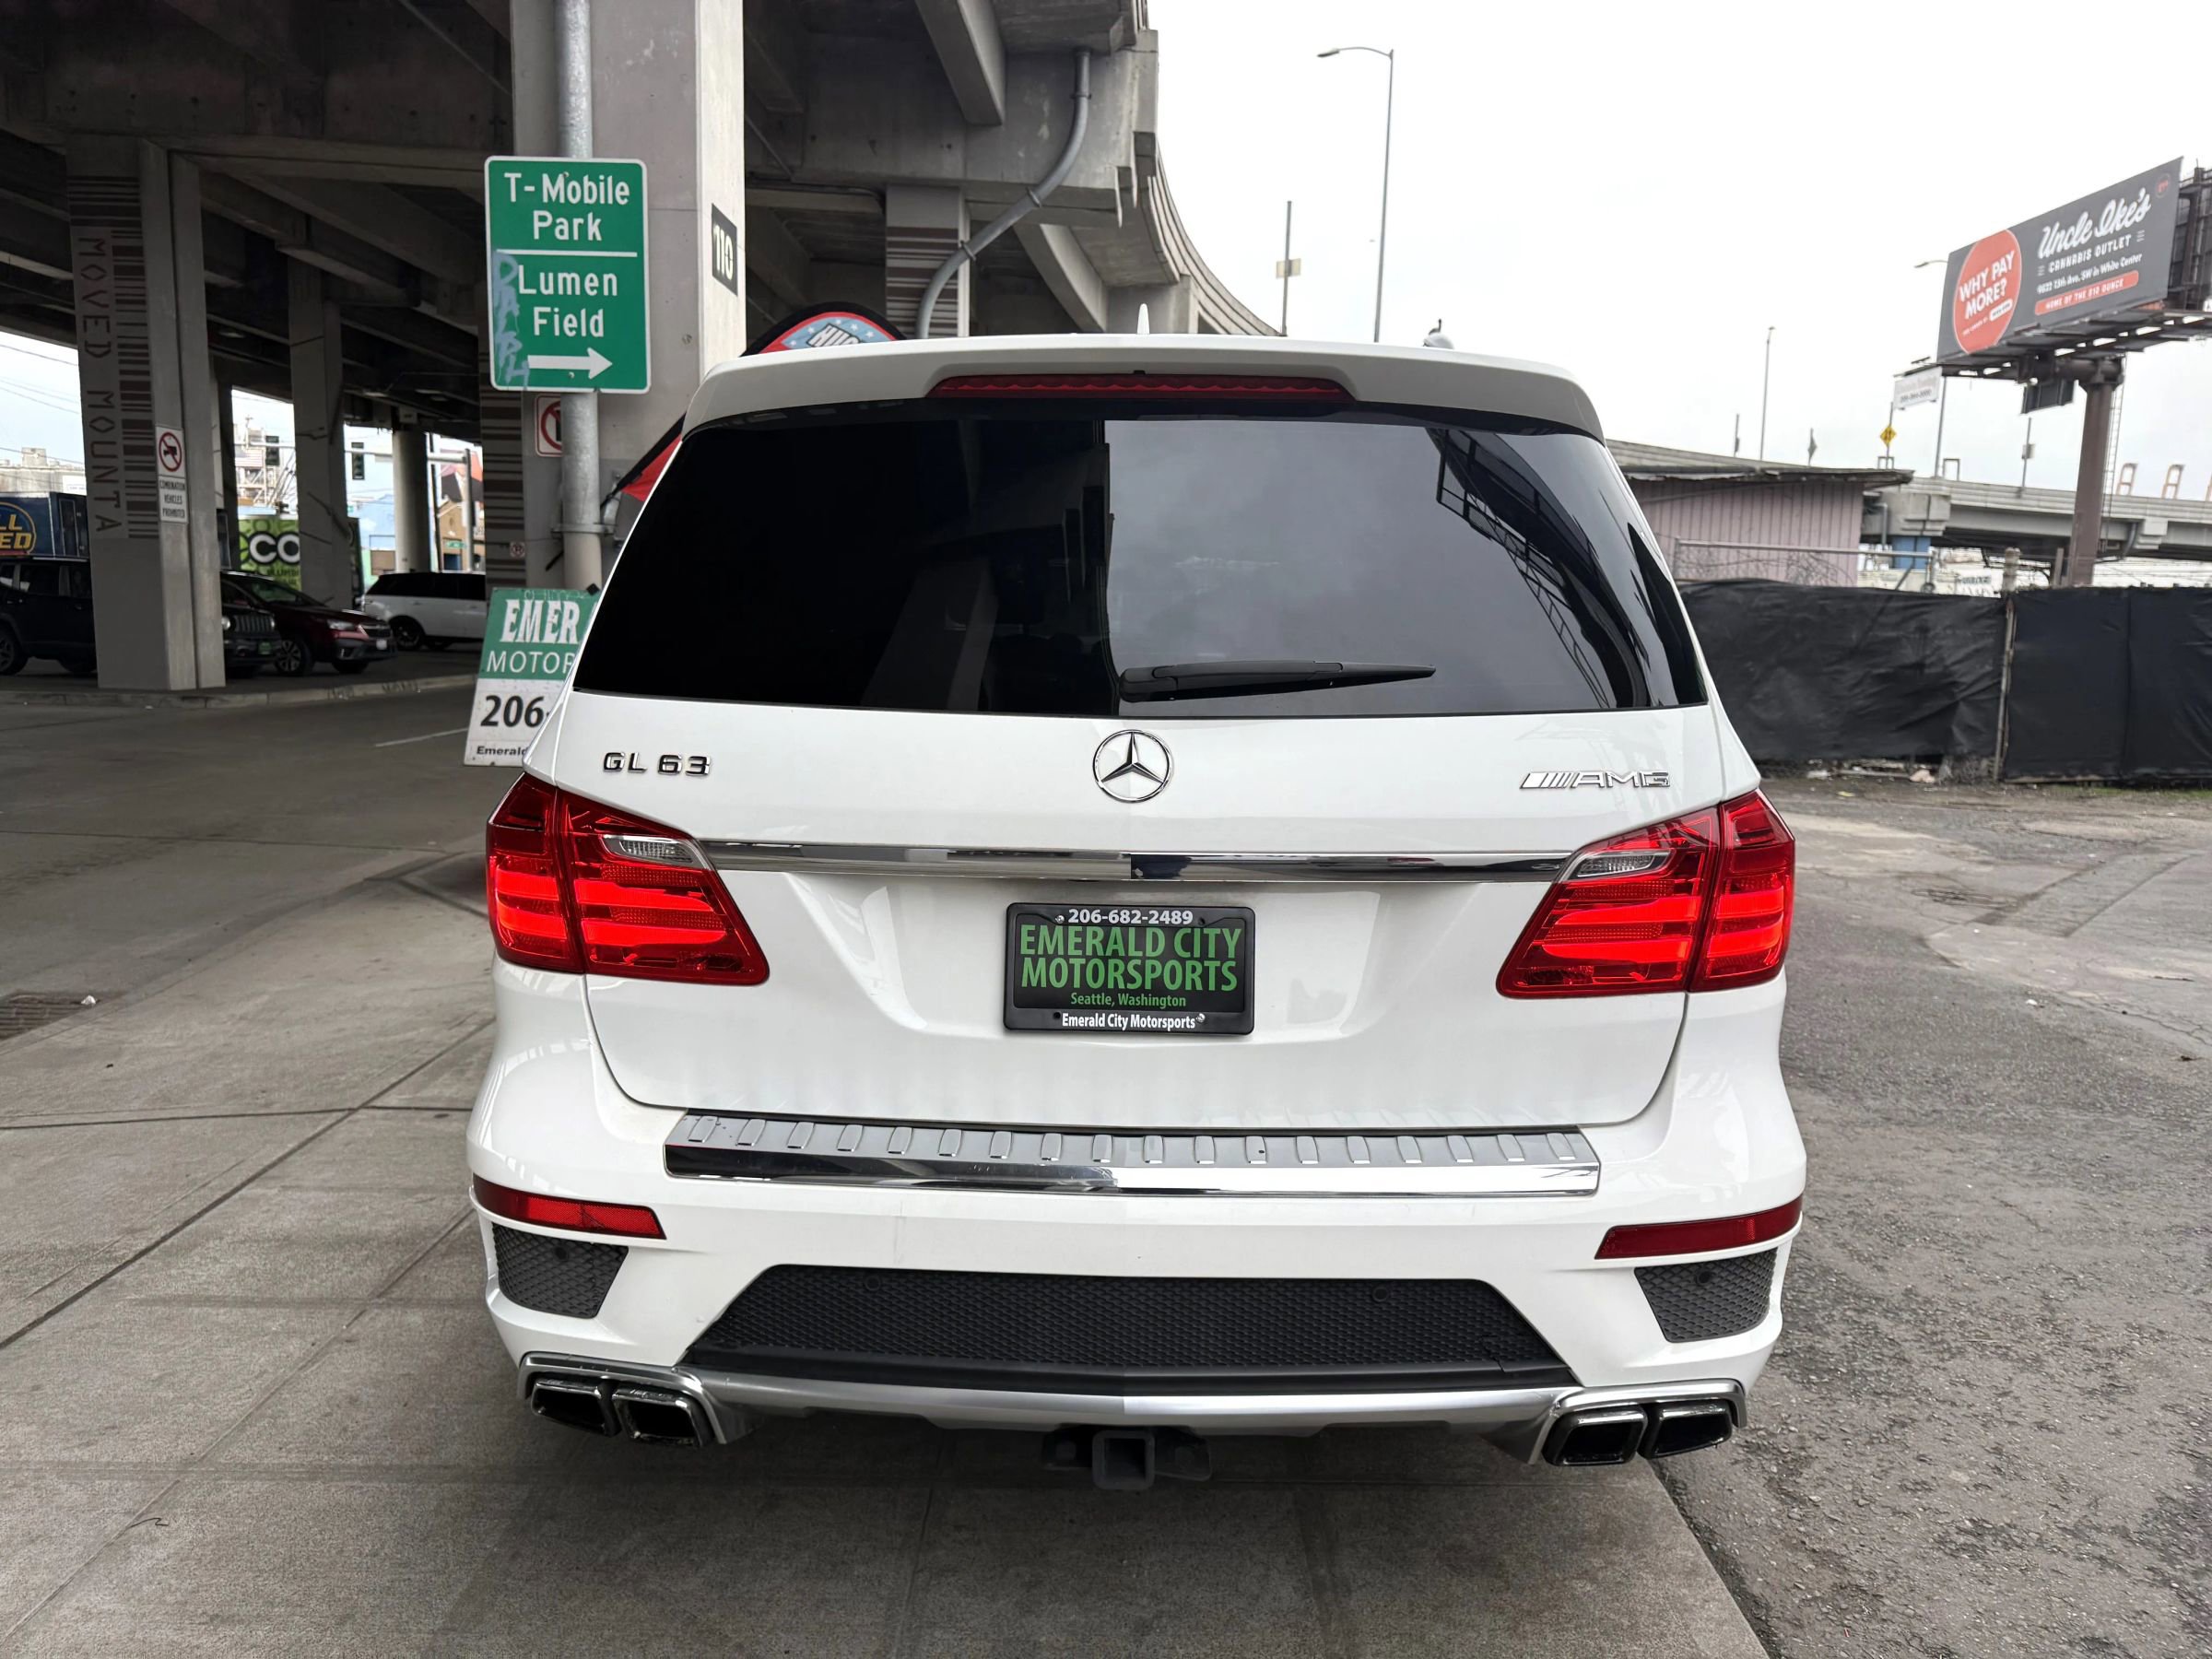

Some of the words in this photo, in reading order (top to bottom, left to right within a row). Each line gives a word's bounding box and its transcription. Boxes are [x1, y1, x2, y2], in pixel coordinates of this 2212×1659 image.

[503, 171, 630, 206] T-Mobile
[532, 209, 603, 241] Park
[2038, 211, 2093, 259] Uncle
[2094, 187, 2151, 238] Ike's
[713, 224, 734, 281] 110
[2048, 248, 2092, 274] CANNABIS
[2095, 234, 2132, 258] OUTLET
[2100, 260, 2120, 274] White
[2120, 253, 2143, 268] Center
[517, 264, 618, 297] Lumen
[1959, 266, 1989, 302] WHY
[1992, 250, 2015, 281] PAY
[77, 237, 112, 359] MOVED
[1965, 277, 2007, 320] MORE?
[532, 306, 605, 337] Field
[500, 599, 597, 644] EMER
[603, 751, 647, 773] GL
[657, 754, 712, 777] 63
[1569, 770, 1671, 789] AMG
[1068, 908, 1194, 925] 206-682-2489
[1019, 924, 1166, 957] EMERALD
[1173, 927, 1241, 959] CITY
[1021, 957, 1238, 992] MOTORSPORTS
[1070, 992, 1115, 1007] Seattle,
[1117, 993, 1186, 1010] Washington
[1062, 1013, 1105, 1028] Emerald
[1107, 1014, 1128, 1031] City
[1130, 1015, 1195, 1031] Motorsports
